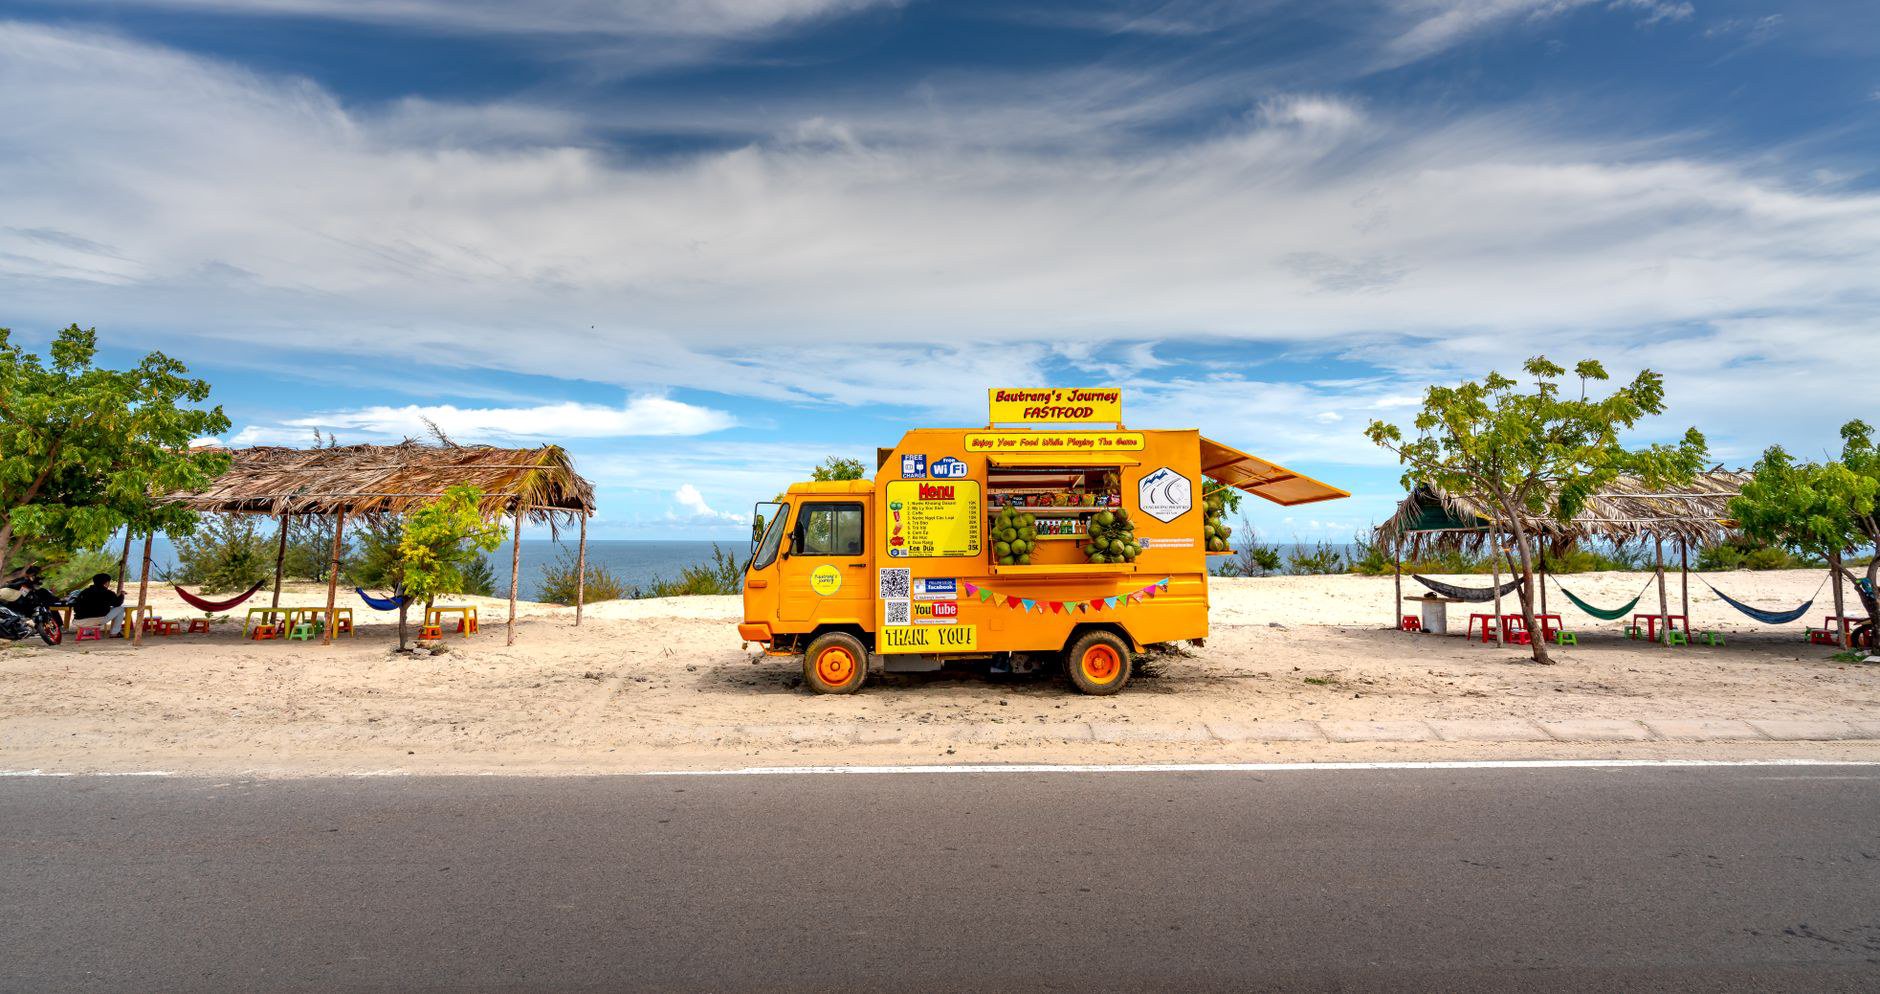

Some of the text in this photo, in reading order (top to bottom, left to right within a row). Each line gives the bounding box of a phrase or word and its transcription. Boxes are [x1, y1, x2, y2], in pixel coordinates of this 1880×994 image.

[995, 389, 1118, 404] Bautrang's Journey
[1023, 406, 1093, 418] FASTFOOD
[972, 437, 1137, 448] Enjoy Your Food While Playing The Game
[919, 482, 954, 499] Menu
[914, 603, 957, 615] YouTube
[885, 627, 971, 646] THANK YOU!
